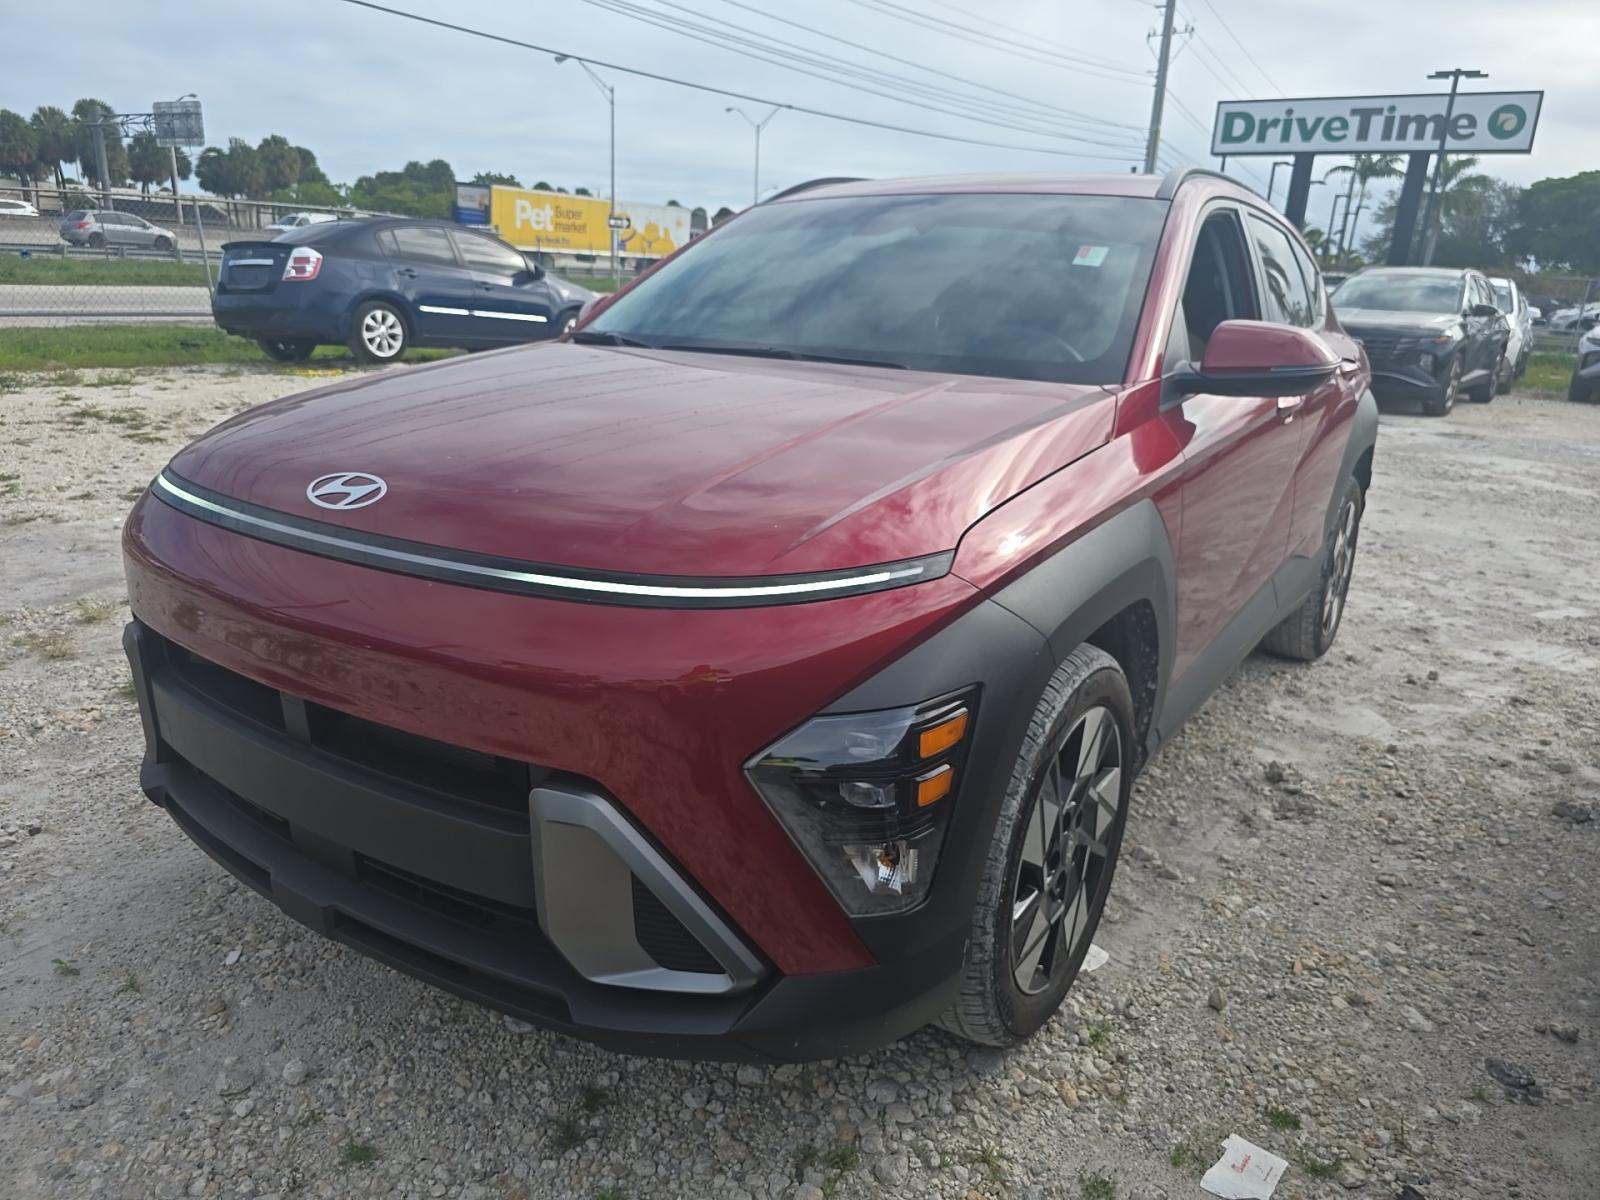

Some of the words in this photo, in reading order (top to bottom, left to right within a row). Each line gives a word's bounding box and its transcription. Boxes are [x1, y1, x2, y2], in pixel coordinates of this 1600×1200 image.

[1221, 105, 1477, 143] DriveTime
[515, 199, 554, 232] Pet
[555, 206, 583, 221] Super
[555, 221, 587, 233] market
